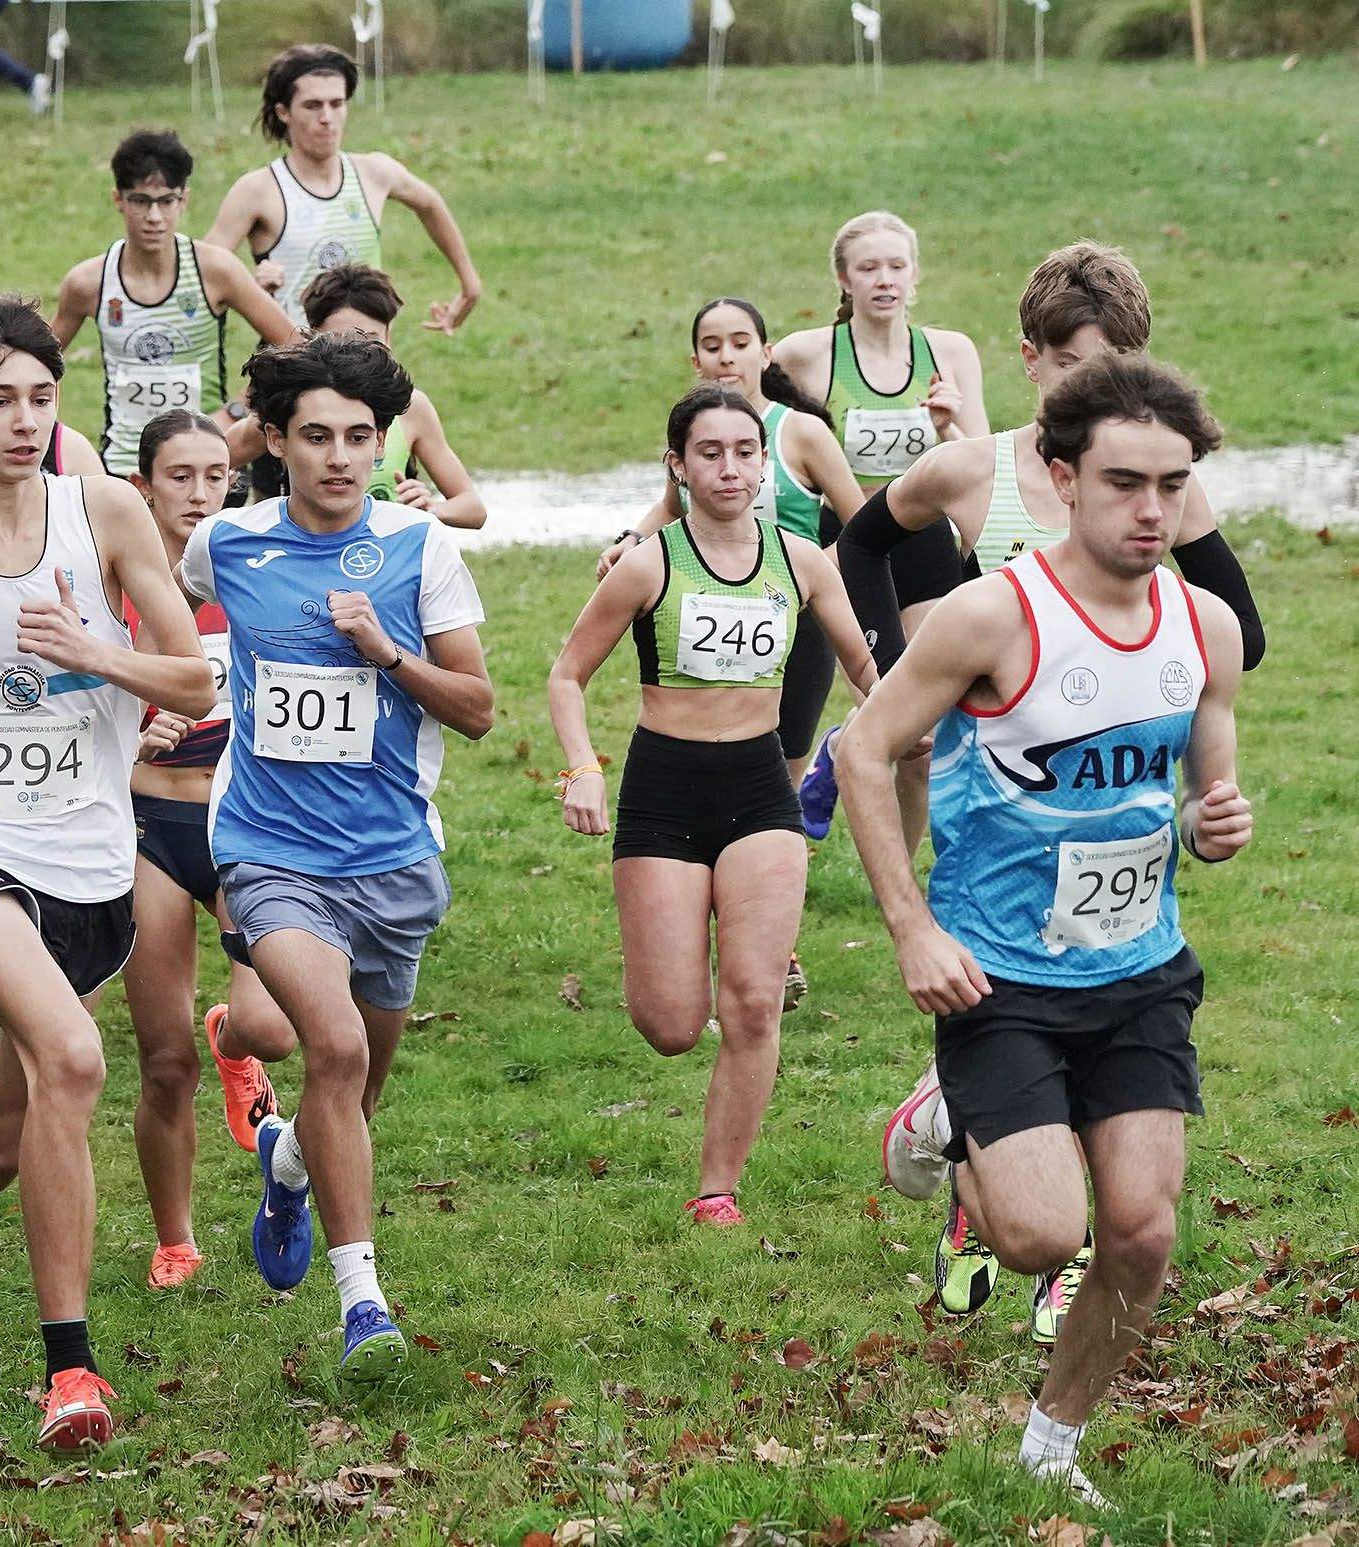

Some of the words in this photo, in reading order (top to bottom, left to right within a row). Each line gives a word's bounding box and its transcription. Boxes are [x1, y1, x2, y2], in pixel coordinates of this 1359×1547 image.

[128, 381, 189, 407] 253
[856, 428, 926, 457] 278
[1011, 542, 1025, 552] IN
[692, 615, 775, 657] 246
[267, 686, 356, 732] 301
[1072, 855, 1163, 916] 295
